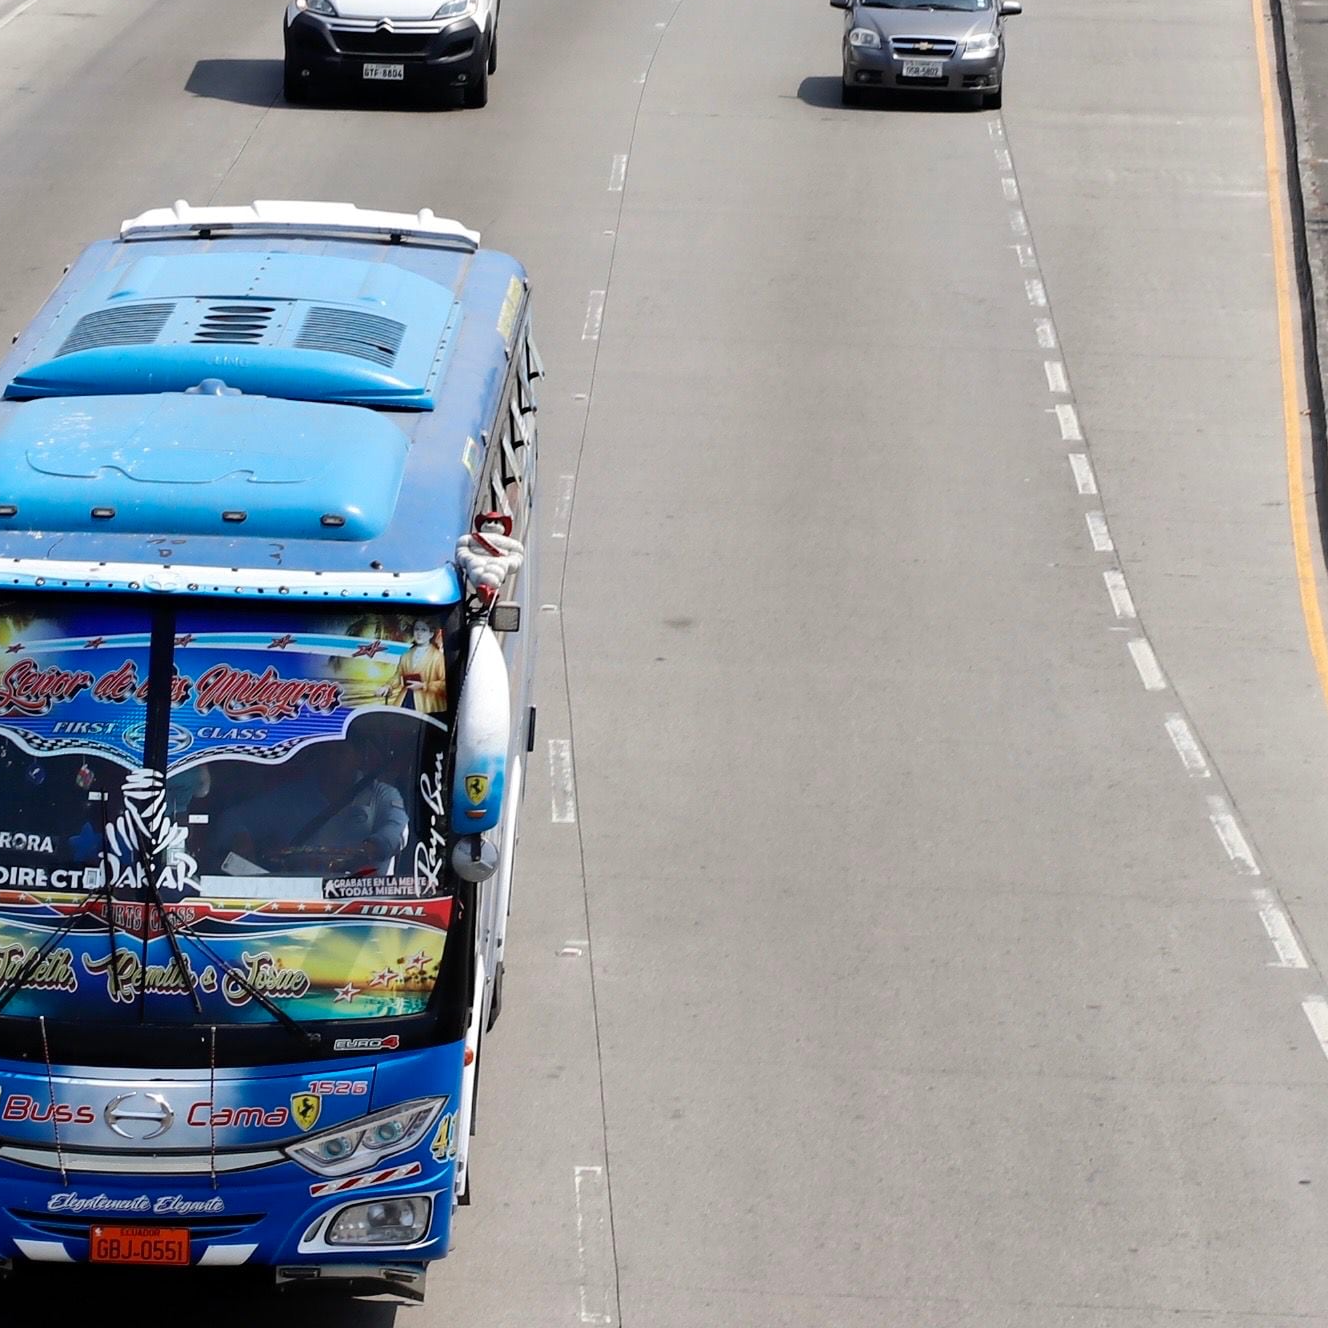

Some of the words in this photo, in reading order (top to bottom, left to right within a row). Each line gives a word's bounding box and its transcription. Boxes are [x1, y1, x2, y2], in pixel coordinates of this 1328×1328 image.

[92, 659, 138, 704] de
[194, 662, 344, 724] Milagros
[52, 722, 119, 735] FIRST
[197, 726, 269, 741] CLASS
[414, 752, 446, 898] Ray-Ban
[339, 886, 374, 897] TODAS
[373, 878, 388, 887] EN
[388, 877, 399, 887] LA
[360, 904, 427, 917] TOTAL
[334, 1035, 400, 1050] EURO4
[308, 1080, 369, 1096] 1526
[1, 1094, 96, 1125] Buss
[186, 1101, 289, 1128] Cama
[153, 1194, 225, 1215] Elegante
[96, 1238, 184, 1261] GBJ-0551
